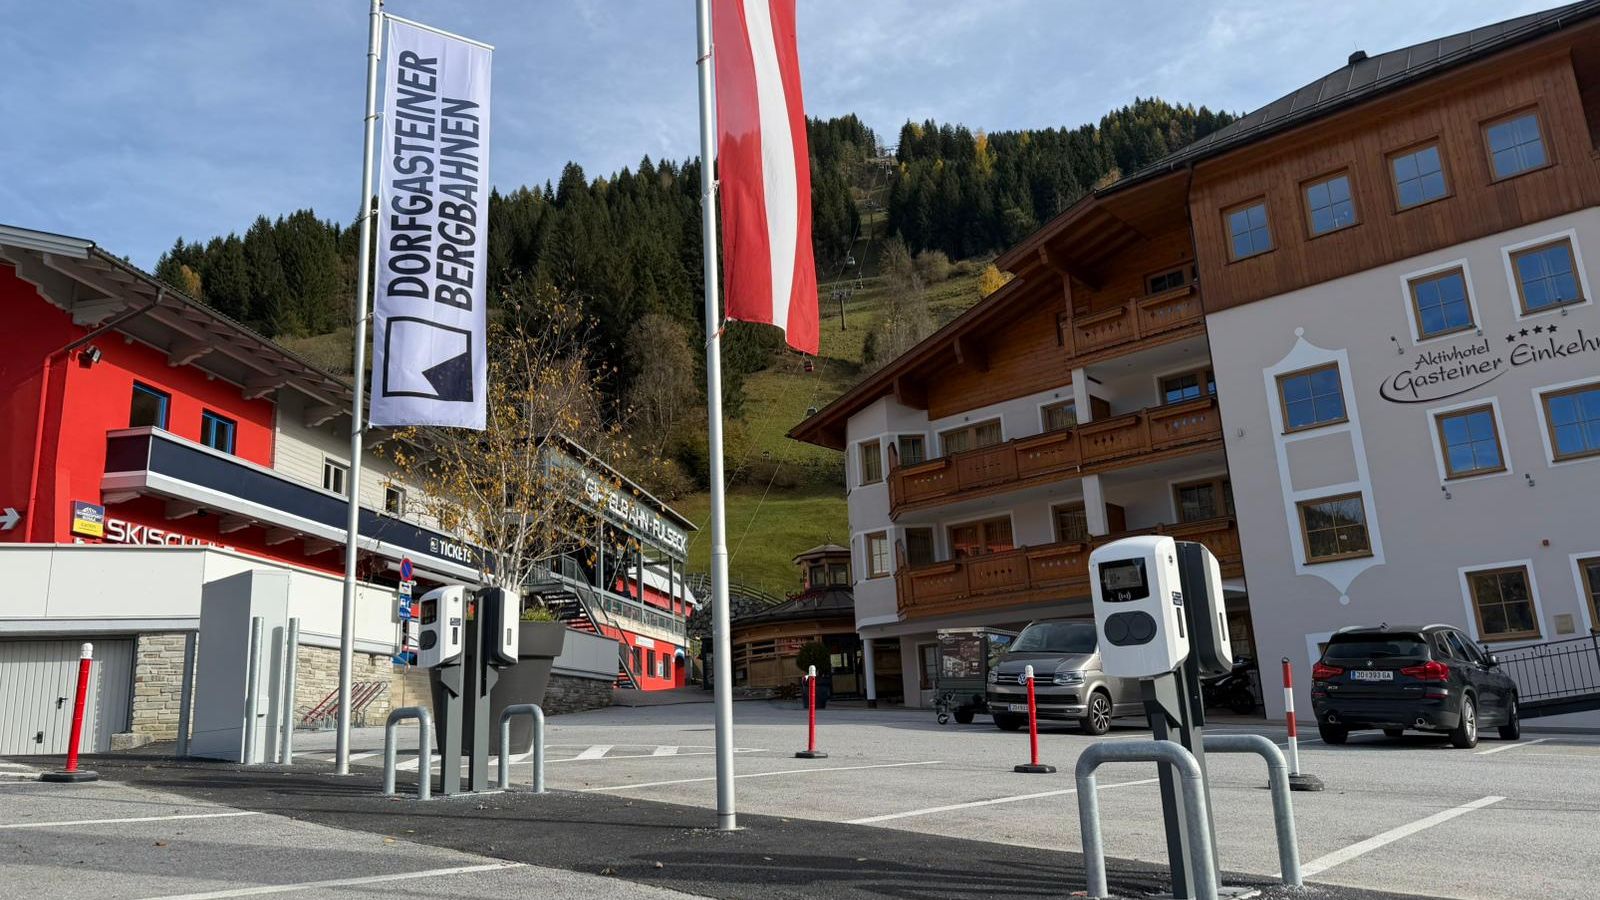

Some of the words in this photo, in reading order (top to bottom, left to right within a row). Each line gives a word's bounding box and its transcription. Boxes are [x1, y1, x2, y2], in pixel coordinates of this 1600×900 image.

[387, 50, 437, 300] DORFGASTEINER
[434, 97, 480, 312] BERGBAHNEN
[1414, 339, 1490, 370] Aktivhotel
[1393, 358, 1503, 399] Gasteiner
[439, 541, 472, 563] TICKETS
